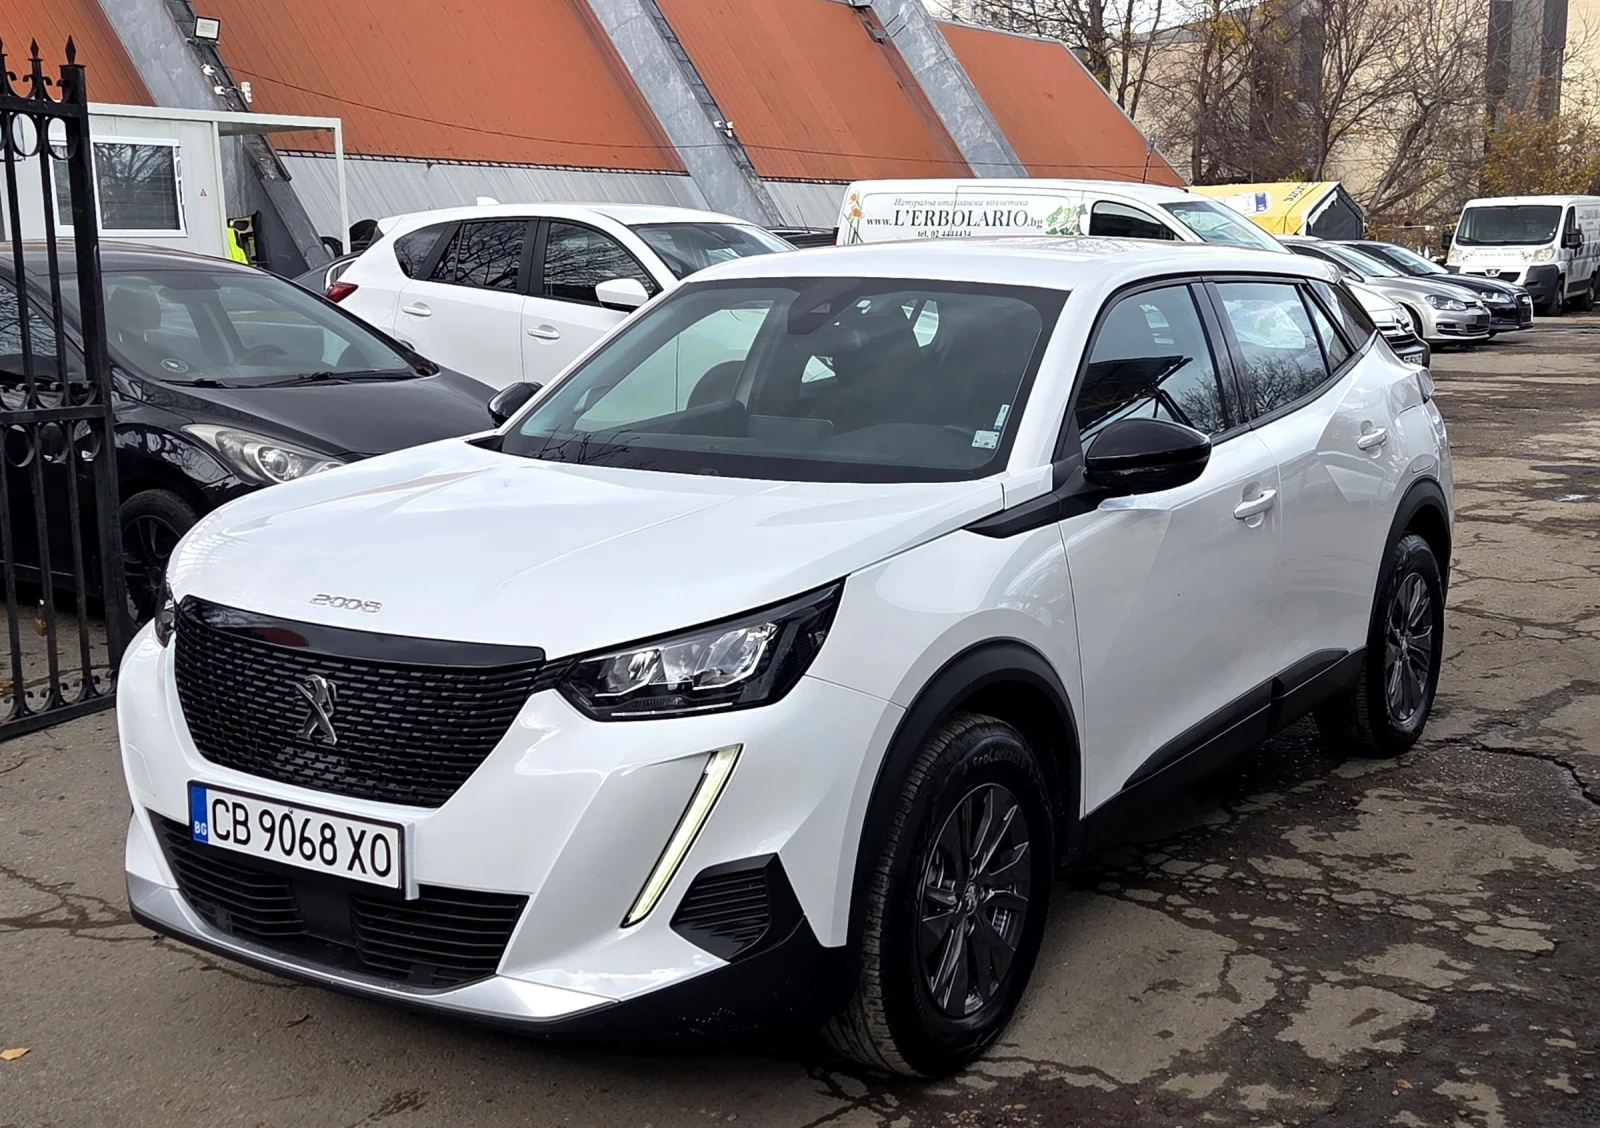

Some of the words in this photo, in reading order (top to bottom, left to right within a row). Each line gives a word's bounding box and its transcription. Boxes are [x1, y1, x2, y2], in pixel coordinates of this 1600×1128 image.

[866, 209, 1043, 230] www.L'ERBOLARIO.bg
[309, 594, 382, 613] 2008
[194, 821, 207, 836] BG
[212, 798, 251, 846] CB
[258, 808, 338, 867] 9068
